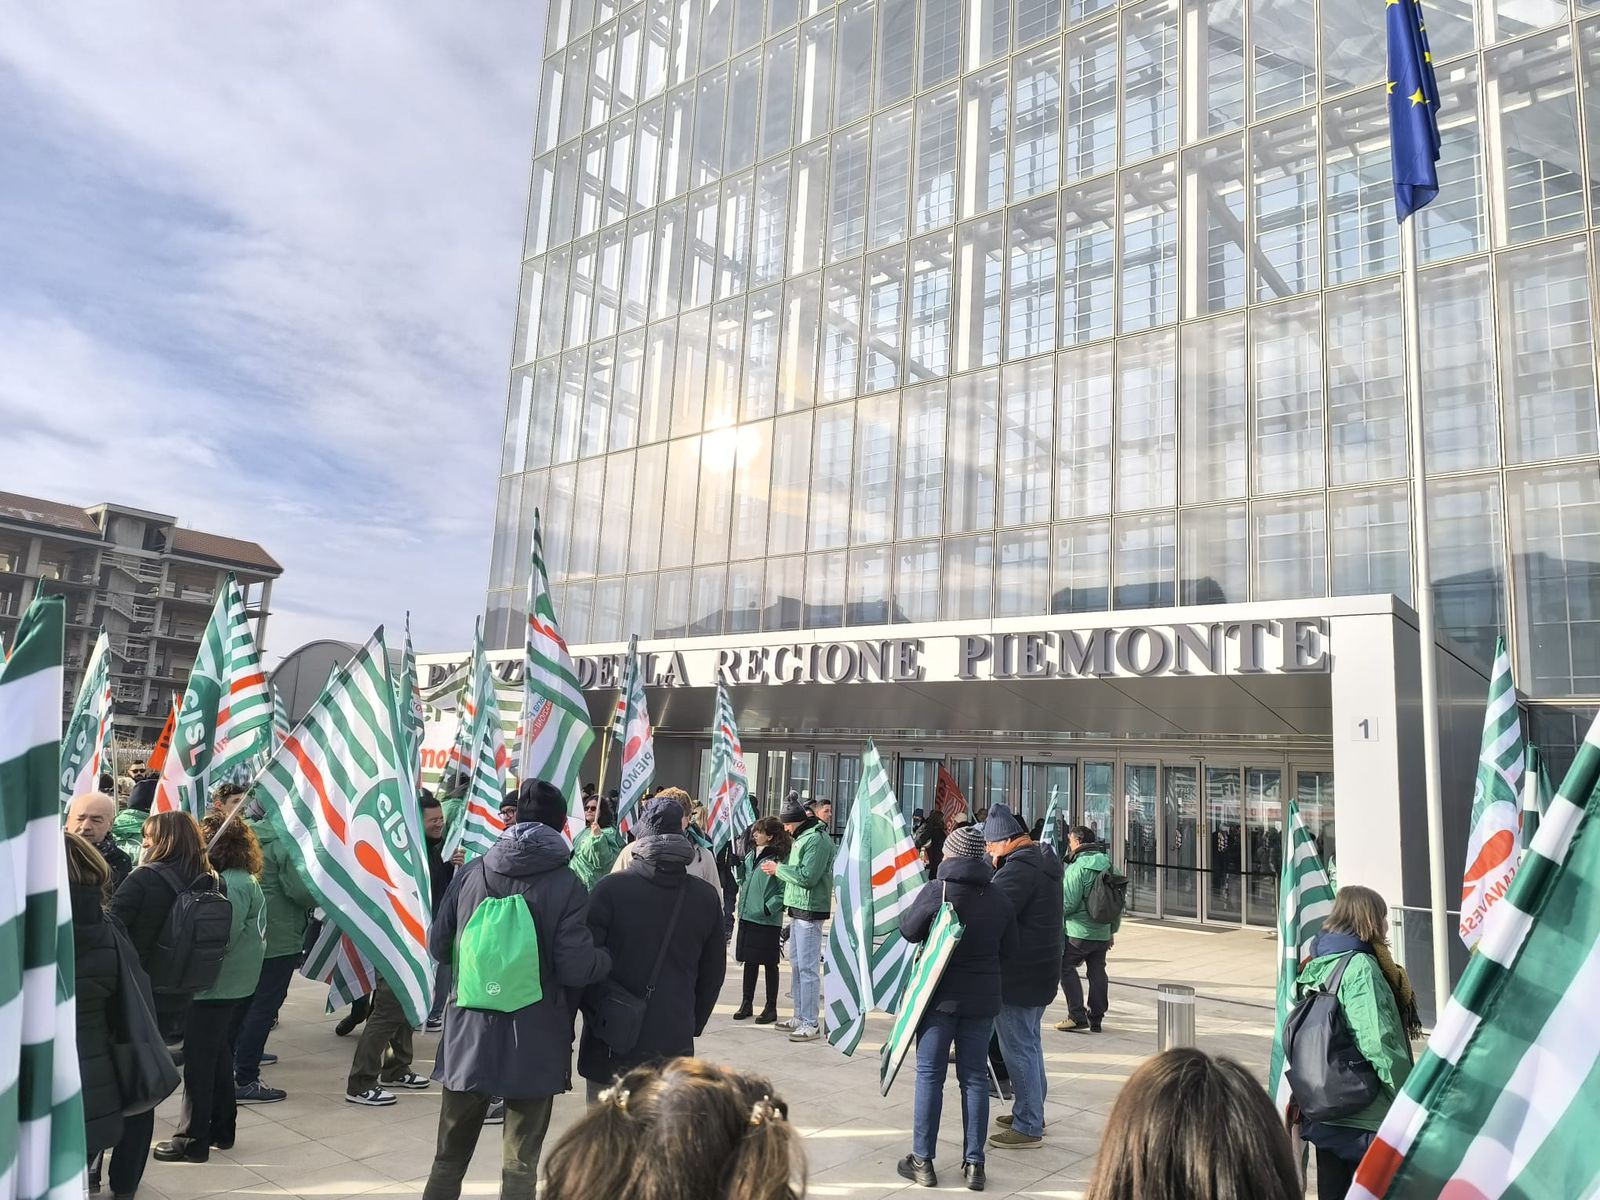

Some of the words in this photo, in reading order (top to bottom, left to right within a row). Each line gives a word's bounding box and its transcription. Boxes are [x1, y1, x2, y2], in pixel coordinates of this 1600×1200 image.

[713, 638, 925, 684] REGIONE
[955, 616, 1331, 679] PIEMONTE
[179, 688, 206, 767] CISL
[1358, 718, 1370, 740] 1
[377, 792, 413, 865] CIS
